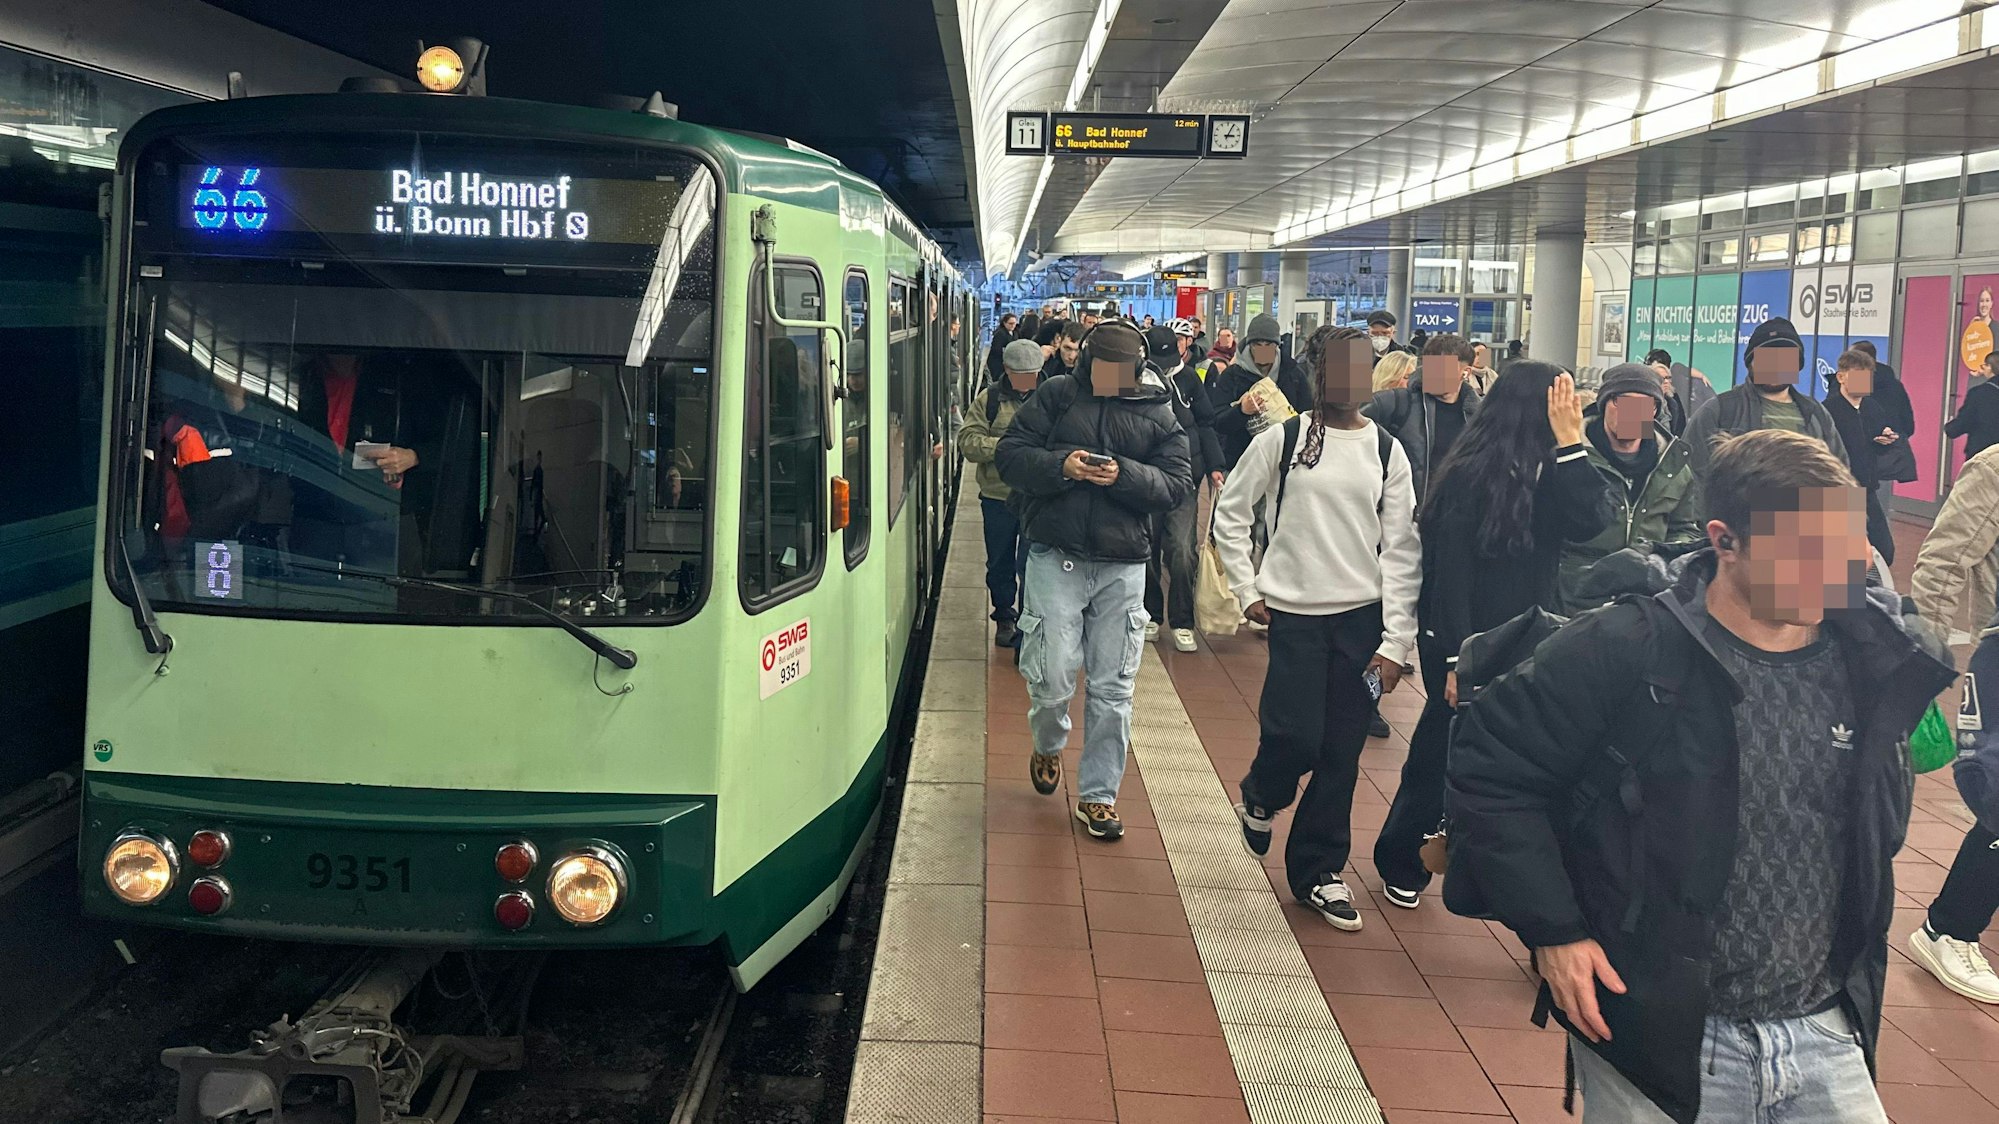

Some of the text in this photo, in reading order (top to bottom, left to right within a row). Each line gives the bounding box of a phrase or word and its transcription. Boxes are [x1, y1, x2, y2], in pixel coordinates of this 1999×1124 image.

[1018, 118, 1035, 127] Gleis
[1055, 125, 1148, 138] 66 Bad Honnef
[1174, 120, 1199, 128] 12 min
[1019, 128, 1034, 145] 11
[1055, 139, 1131, 149] ü. Hauptbahnhof
[193, 166, 268, 230] 66
[392, 169, 571, 209] Bad Honnef
[375, 205, 402, 233] ü.
[412, 206, 491, 237] Bonn
[500, 209, 556, 239] Hbf
[1825, 283, 1873, 304] SWB
[1415, 314, 1439, 325] TAXI
[1636, 304, 1769, 323] EIN RICHTIG KLUGER ZUG
[1823, 307, 1878, 318] Stadtweke Bonn
[778, 622, 808, 651] SWB
[780, 659, 800, 684] 9351
[93, 743, 109, 752] VRS
[306, 852, 411, 893] 9351
[352, 897, 368, 916] A
